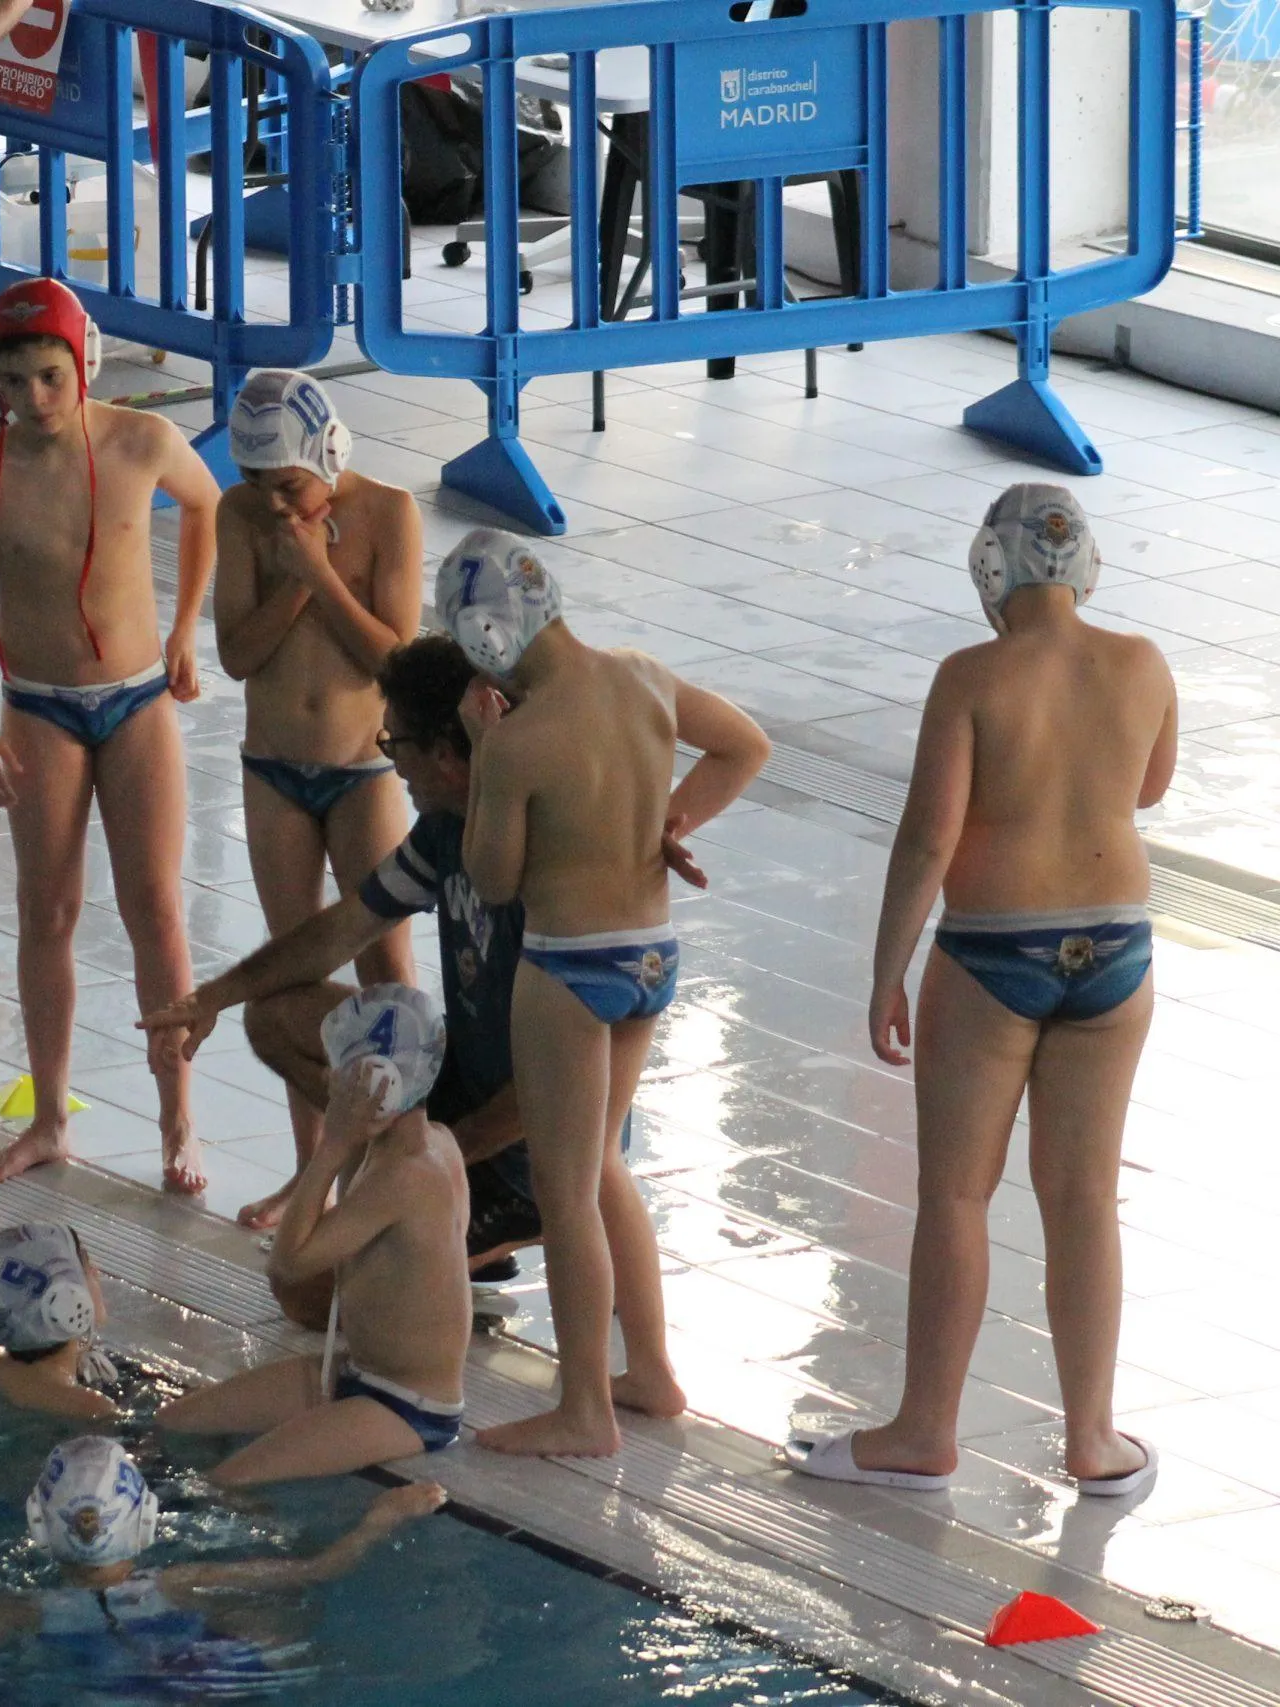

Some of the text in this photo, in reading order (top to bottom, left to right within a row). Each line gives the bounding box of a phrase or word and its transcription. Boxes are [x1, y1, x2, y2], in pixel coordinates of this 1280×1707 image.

[1, 77, 45, 99] EL PASO
[747, 68, 788, 81] distrito
[747, 79, 813, 96] carabanchel
[720, 101, 817, 129] MADRID
[284, 382, 330, 438] 10
[459, 556, 484, 606] 7
[366, 1005, 398, 1057] 4
[0, 1257, 48, 1299] 5
